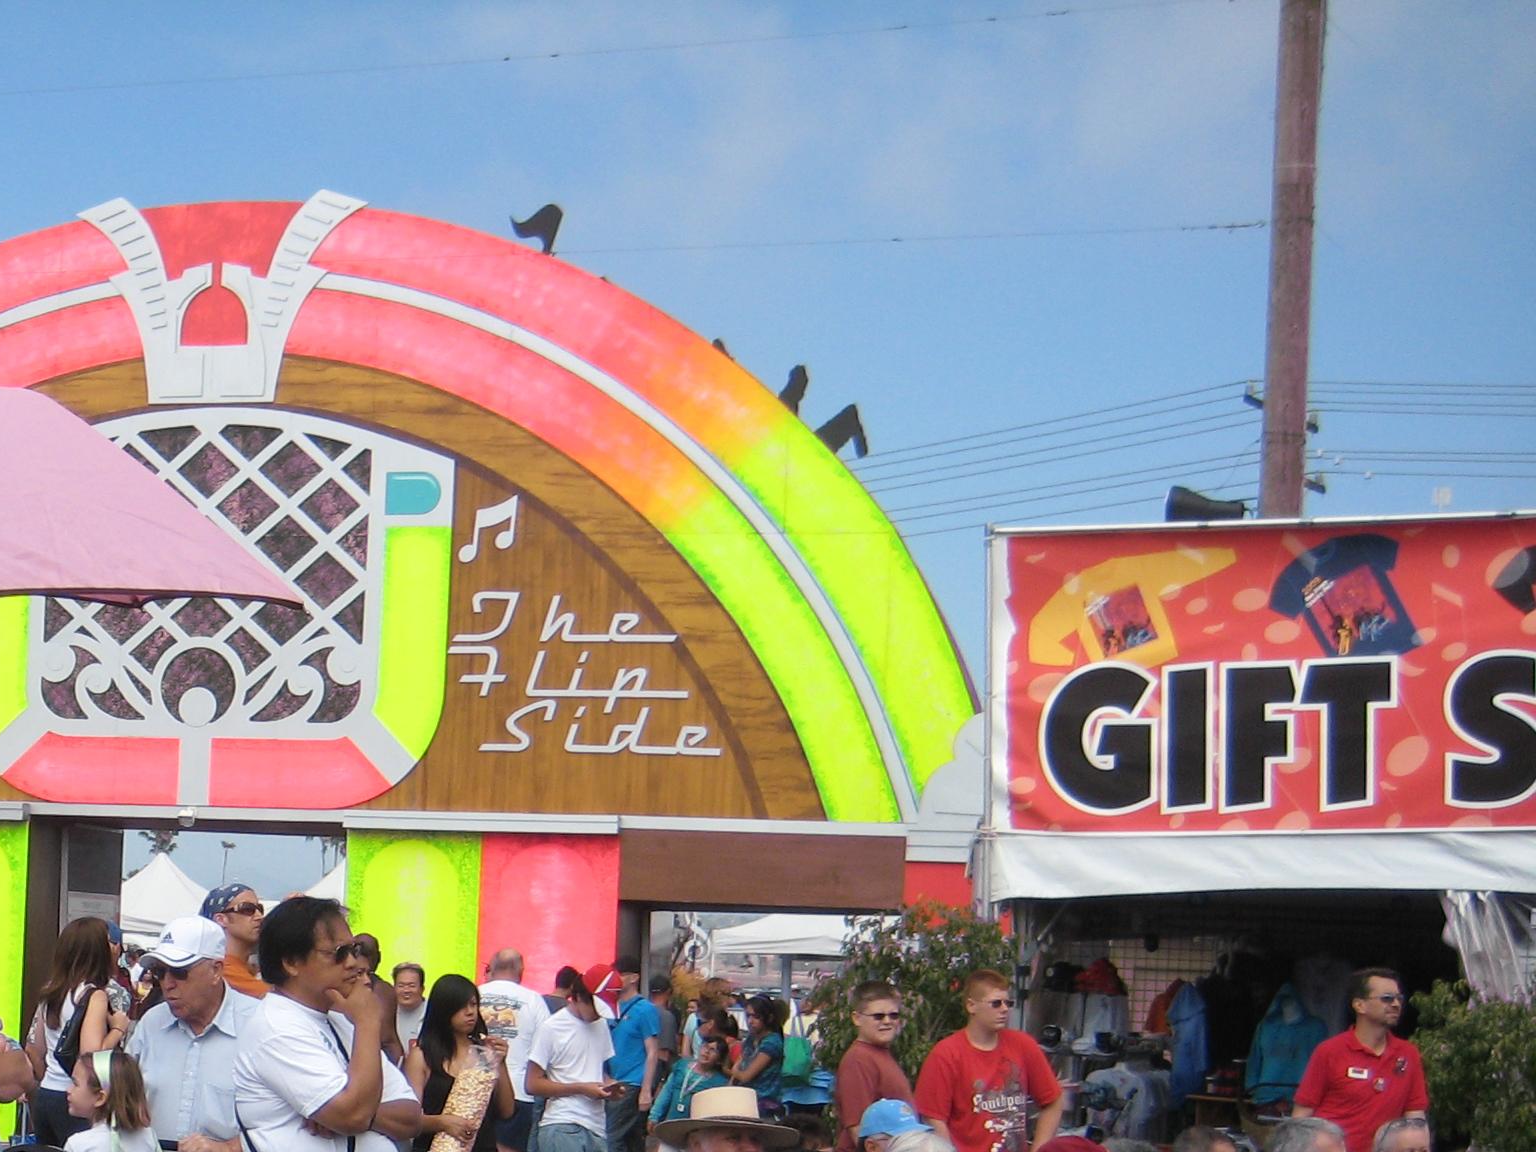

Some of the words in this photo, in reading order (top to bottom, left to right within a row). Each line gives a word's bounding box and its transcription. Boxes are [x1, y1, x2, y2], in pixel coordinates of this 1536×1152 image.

[451, 591, 678, 643] The
[447, 645, 689, 714] Flip
[478, 699, 722, 757] Side
[1037, 655, 1400, 816] GIFT
